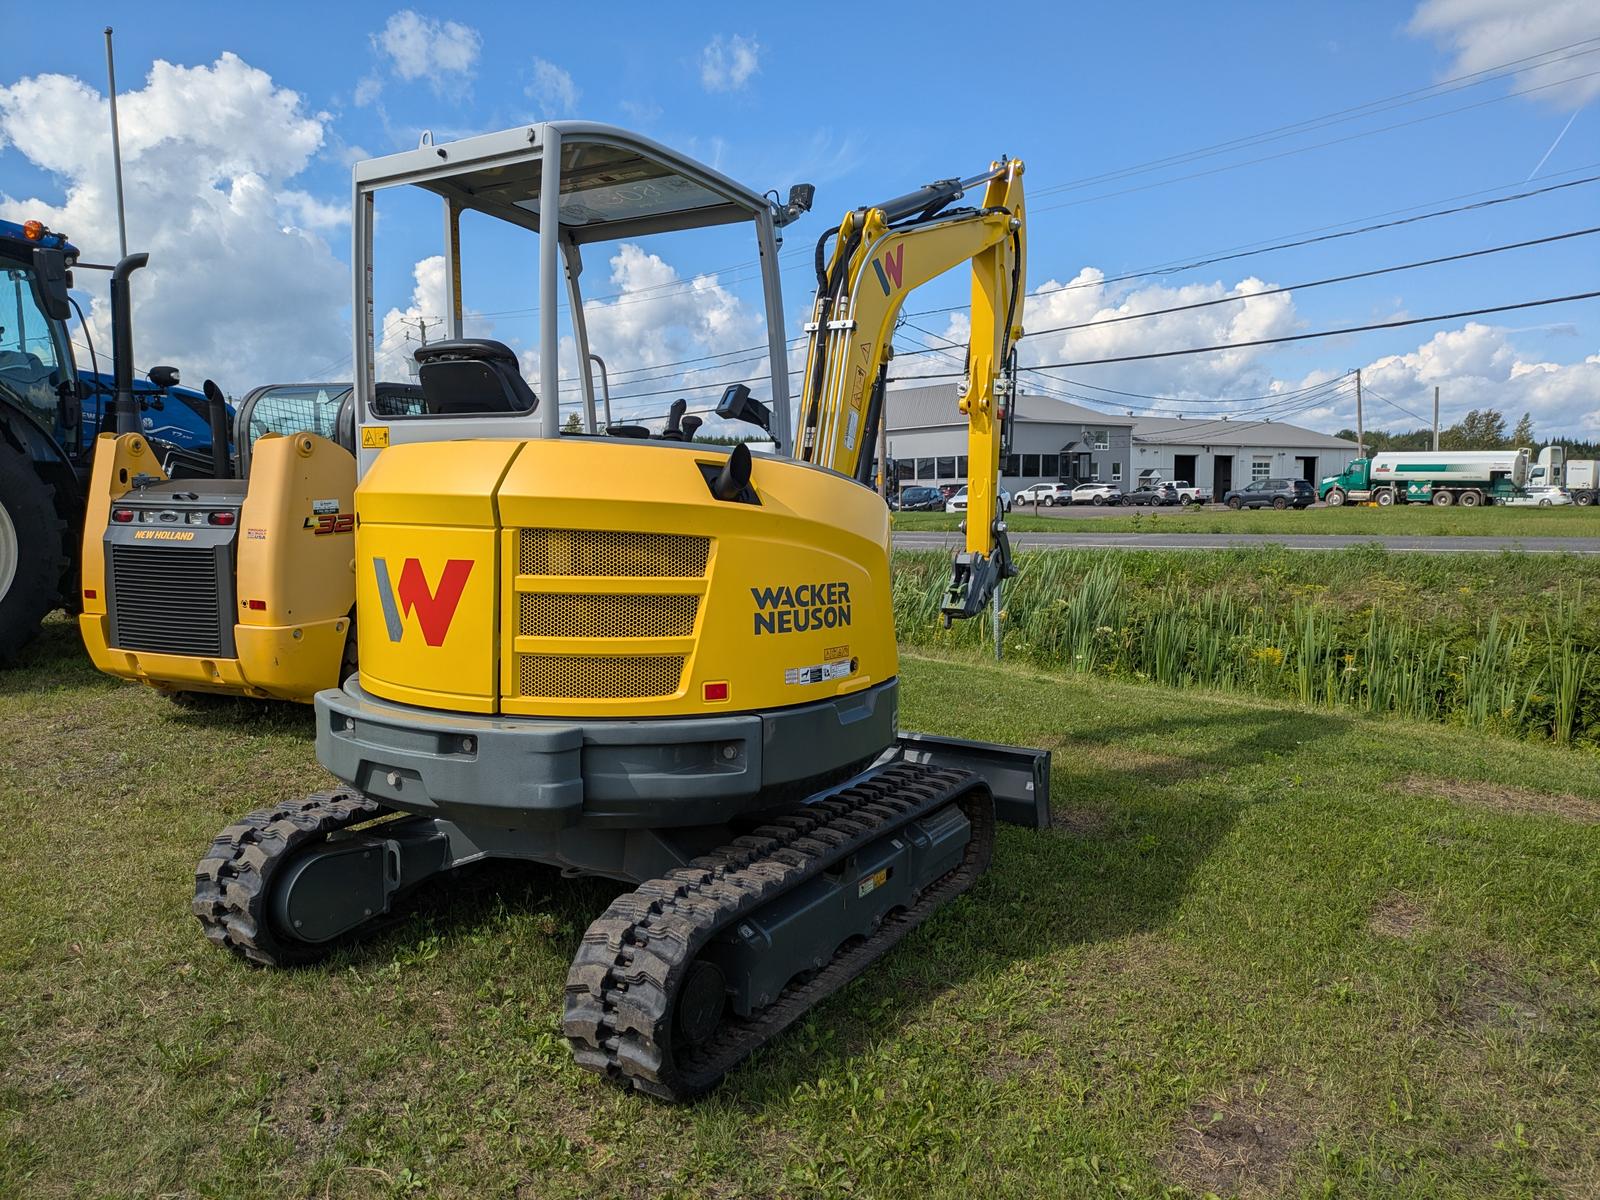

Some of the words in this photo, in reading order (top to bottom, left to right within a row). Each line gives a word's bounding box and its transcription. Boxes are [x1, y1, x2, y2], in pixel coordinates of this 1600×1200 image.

[134, 530, 156, 539] NEW
[154, 530, 195, 541] HOLLAND
[750, 581, 851, 610] WACKER
[754, 605, 851, 636] NEUSON
